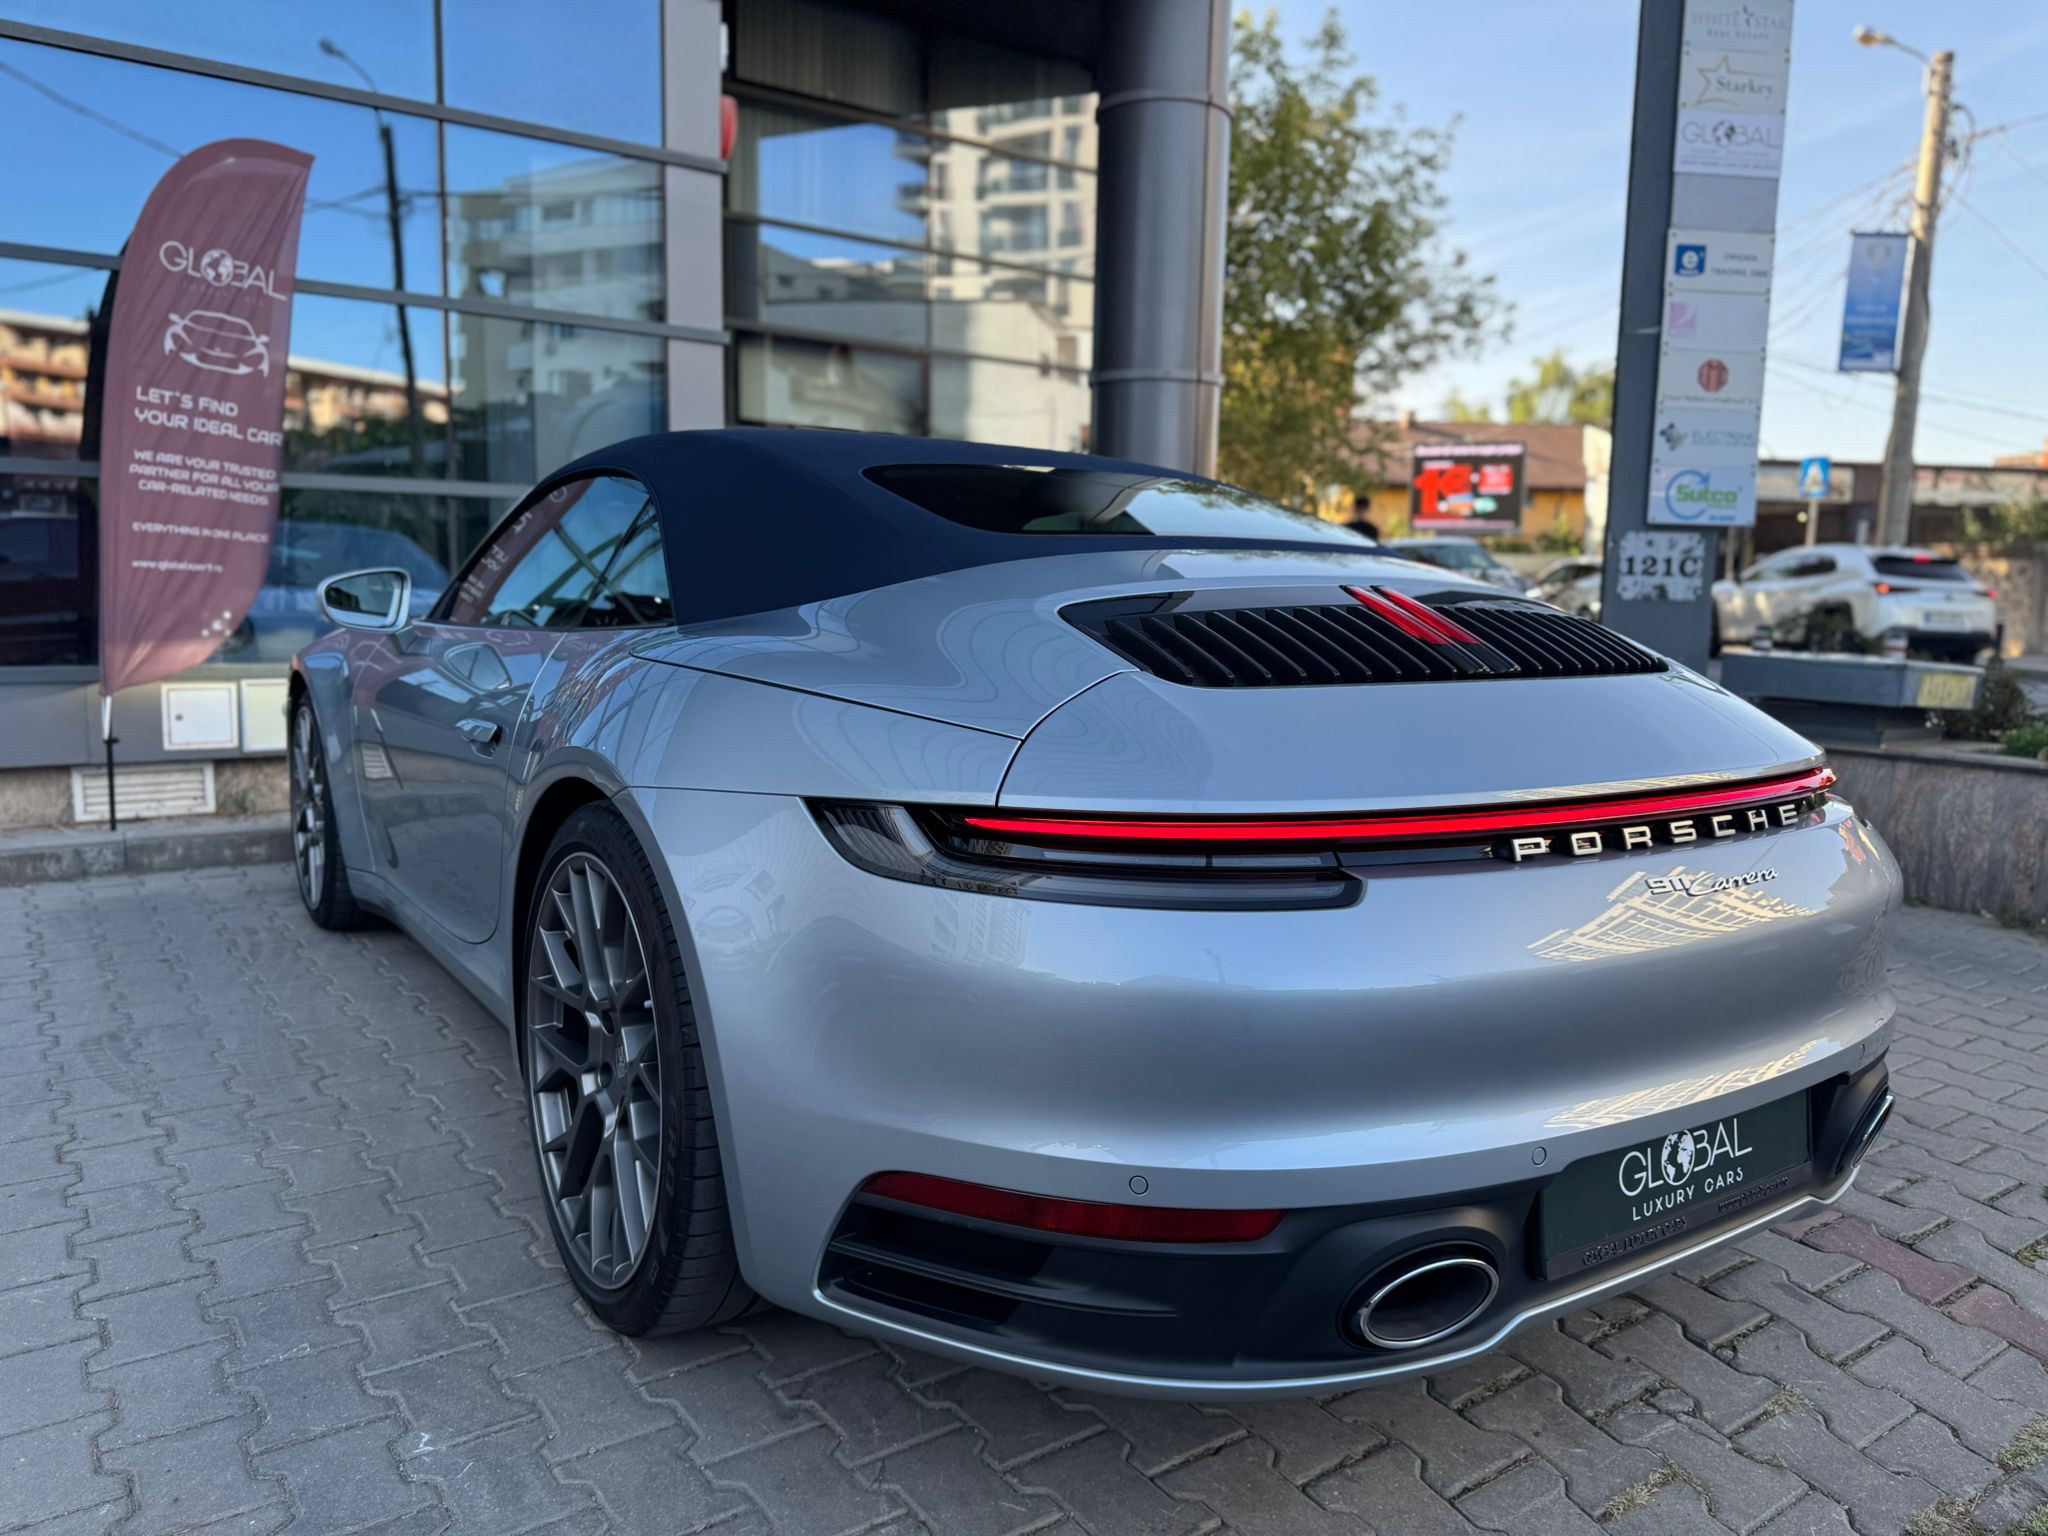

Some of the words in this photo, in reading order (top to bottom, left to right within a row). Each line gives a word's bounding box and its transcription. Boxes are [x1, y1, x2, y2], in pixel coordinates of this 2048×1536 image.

[1715, 75, 1774, 100] Starkey
[1681, 120, 1780, 149] GLOBAL
[159, 240, 287, 301] GLOBAL
[198, 396, 239, 417] FIND
[134, 407, 189, 430] YOUR
[193, 417, 244, 440] IDEAL
[246, 427, 283, 446] CAR
[128, 463, 190, 481] PARTNER
[192, 471, 219, 485] FOR
[221, 475, 242, 489] ALL
[243, 479, 280, 493] YOUR
[134, 449, 153, 462] WE
[156, 452, 183, 466] ARE
[185, 456, 220, 470] YOUR
[222, 461, 277, 480] TRUSTED
[138, 479, 228, 501] CAR-RELATED
[229, 491, 269, 506] NEEDS
[1676, 483, 1738, 504] Sutco
[132, 521, 200, 537] EVERYTHING
[232, 531, 269, 543] PLACE
[1625, 556, 1698, 577] 121C
[1511, 803, 1799, 862] PORSCHE
[1645, 873, 1689, 895] 911
[1687, 867, 1779, 897] Carrera
[1618, 1118, 1753, 1197] GLOBAL
[1632, 1185, 1695, 1221] LUXURY
[1704, 1167, 1744, 1194] CARS
